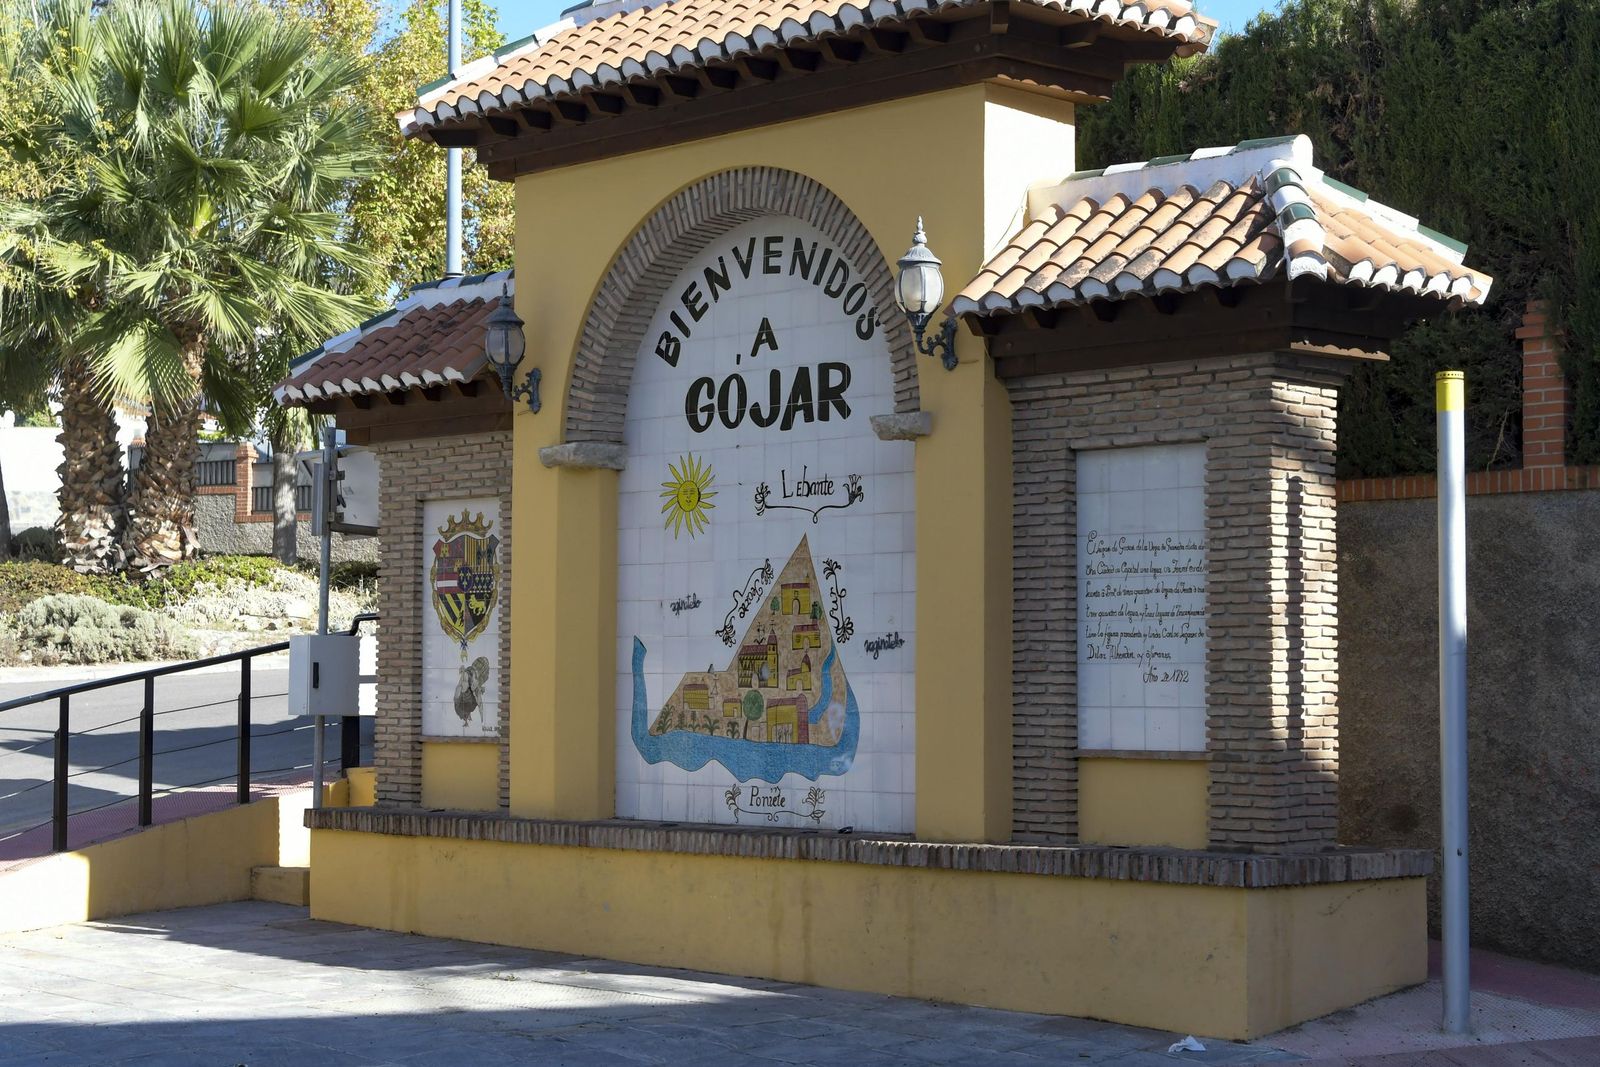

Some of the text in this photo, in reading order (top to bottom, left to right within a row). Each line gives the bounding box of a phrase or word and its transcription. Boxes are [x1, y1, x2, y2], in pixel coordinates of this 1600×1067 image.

[655, 236, 881, 367] BIENVENIDOS
[751, 317, 778, 357] A
[685, 354, 852, 433] GÓJAR
